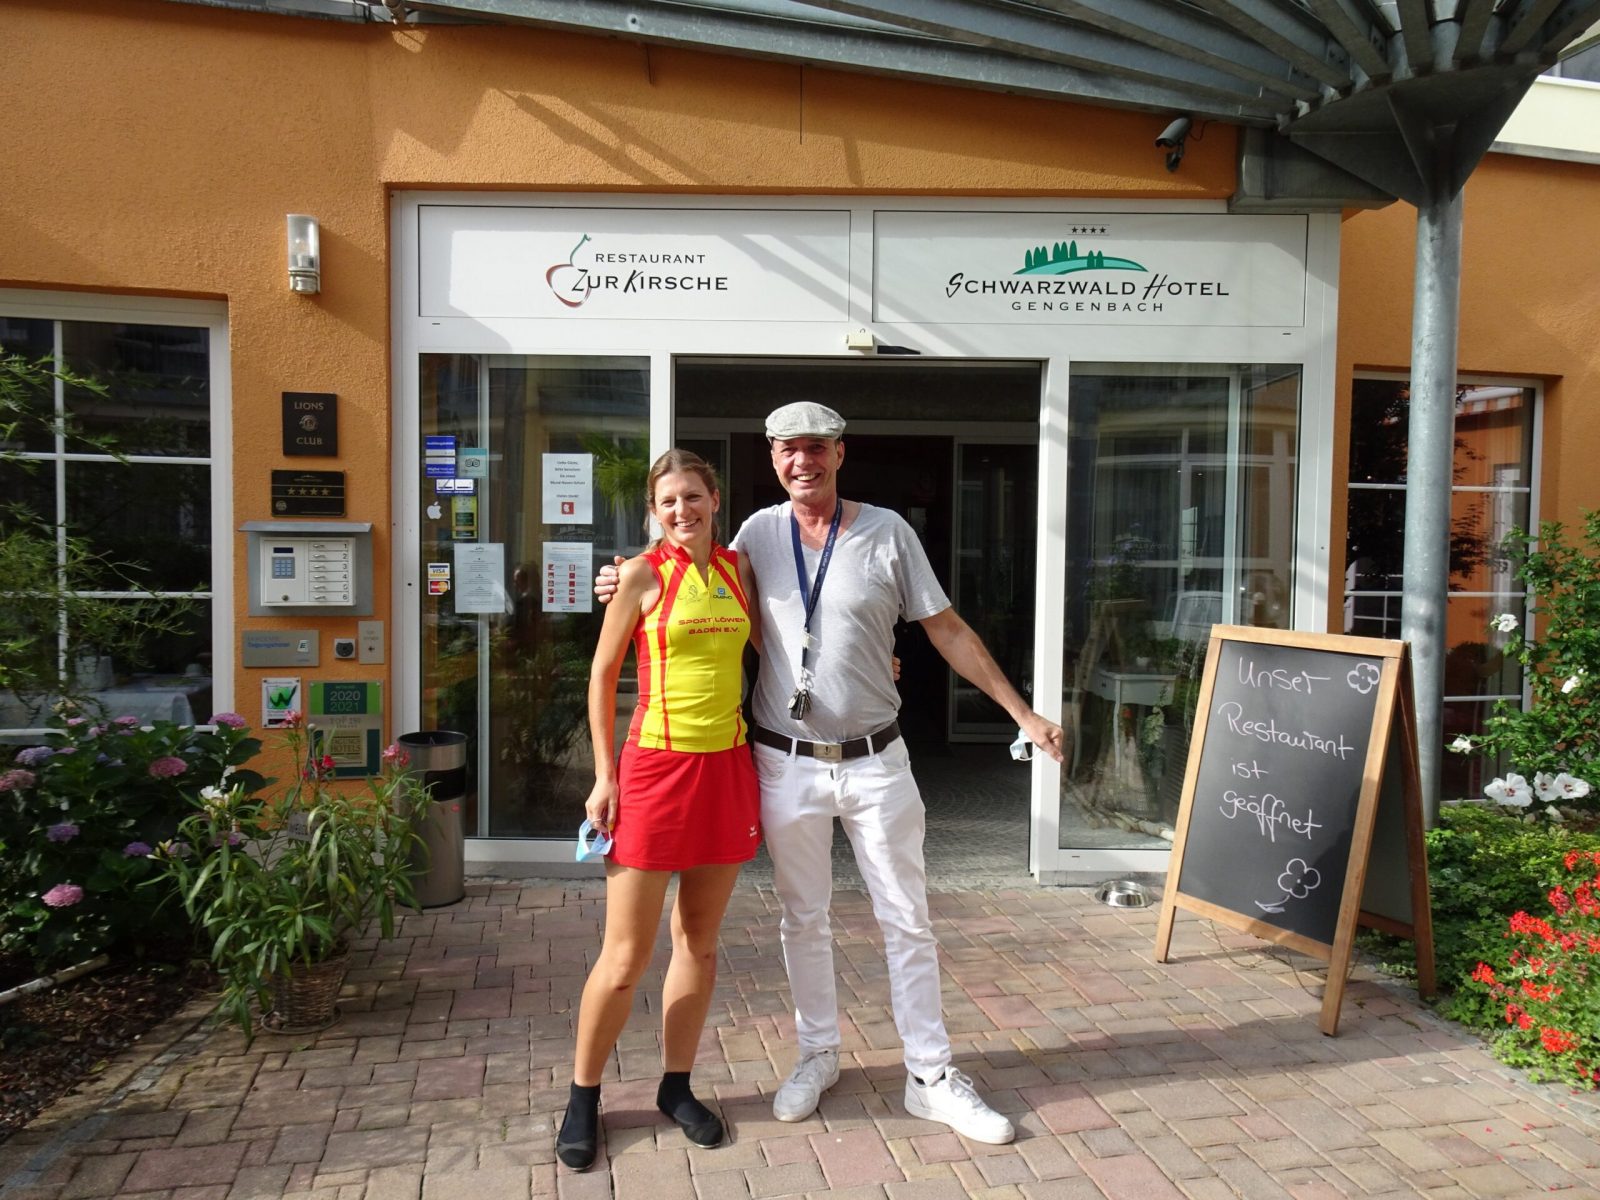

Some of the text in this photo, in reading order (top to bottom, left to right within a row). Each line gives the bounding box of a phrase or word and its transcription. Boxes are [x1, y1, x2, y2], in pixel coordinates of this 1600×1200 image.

[595, 253, 706, 264] RESTAURANT
[571, 268, 728, 294] ZUR KIRSCHE
[946, 272, 1230, 300] SCHWARZWALD HOTEL
[1011, 301, 1164, 312] GENGENBACH
[294, 402, 324, 410] LIONS
[296, 437, 323, 445] CLUB
[678, 617, 712, 625] SPORT
[688, 627, 722, 635] BADEN
[1239, 657, 1331, 694] Unser
[330, 690, 361, 701] 2020
[330, 702, 359, 712] 2021
[1217, 701, 1355, 760] Restaurant
[1232, 758, 1269, 780] ist
[1220, 790, 1323, 843] geöffnet
